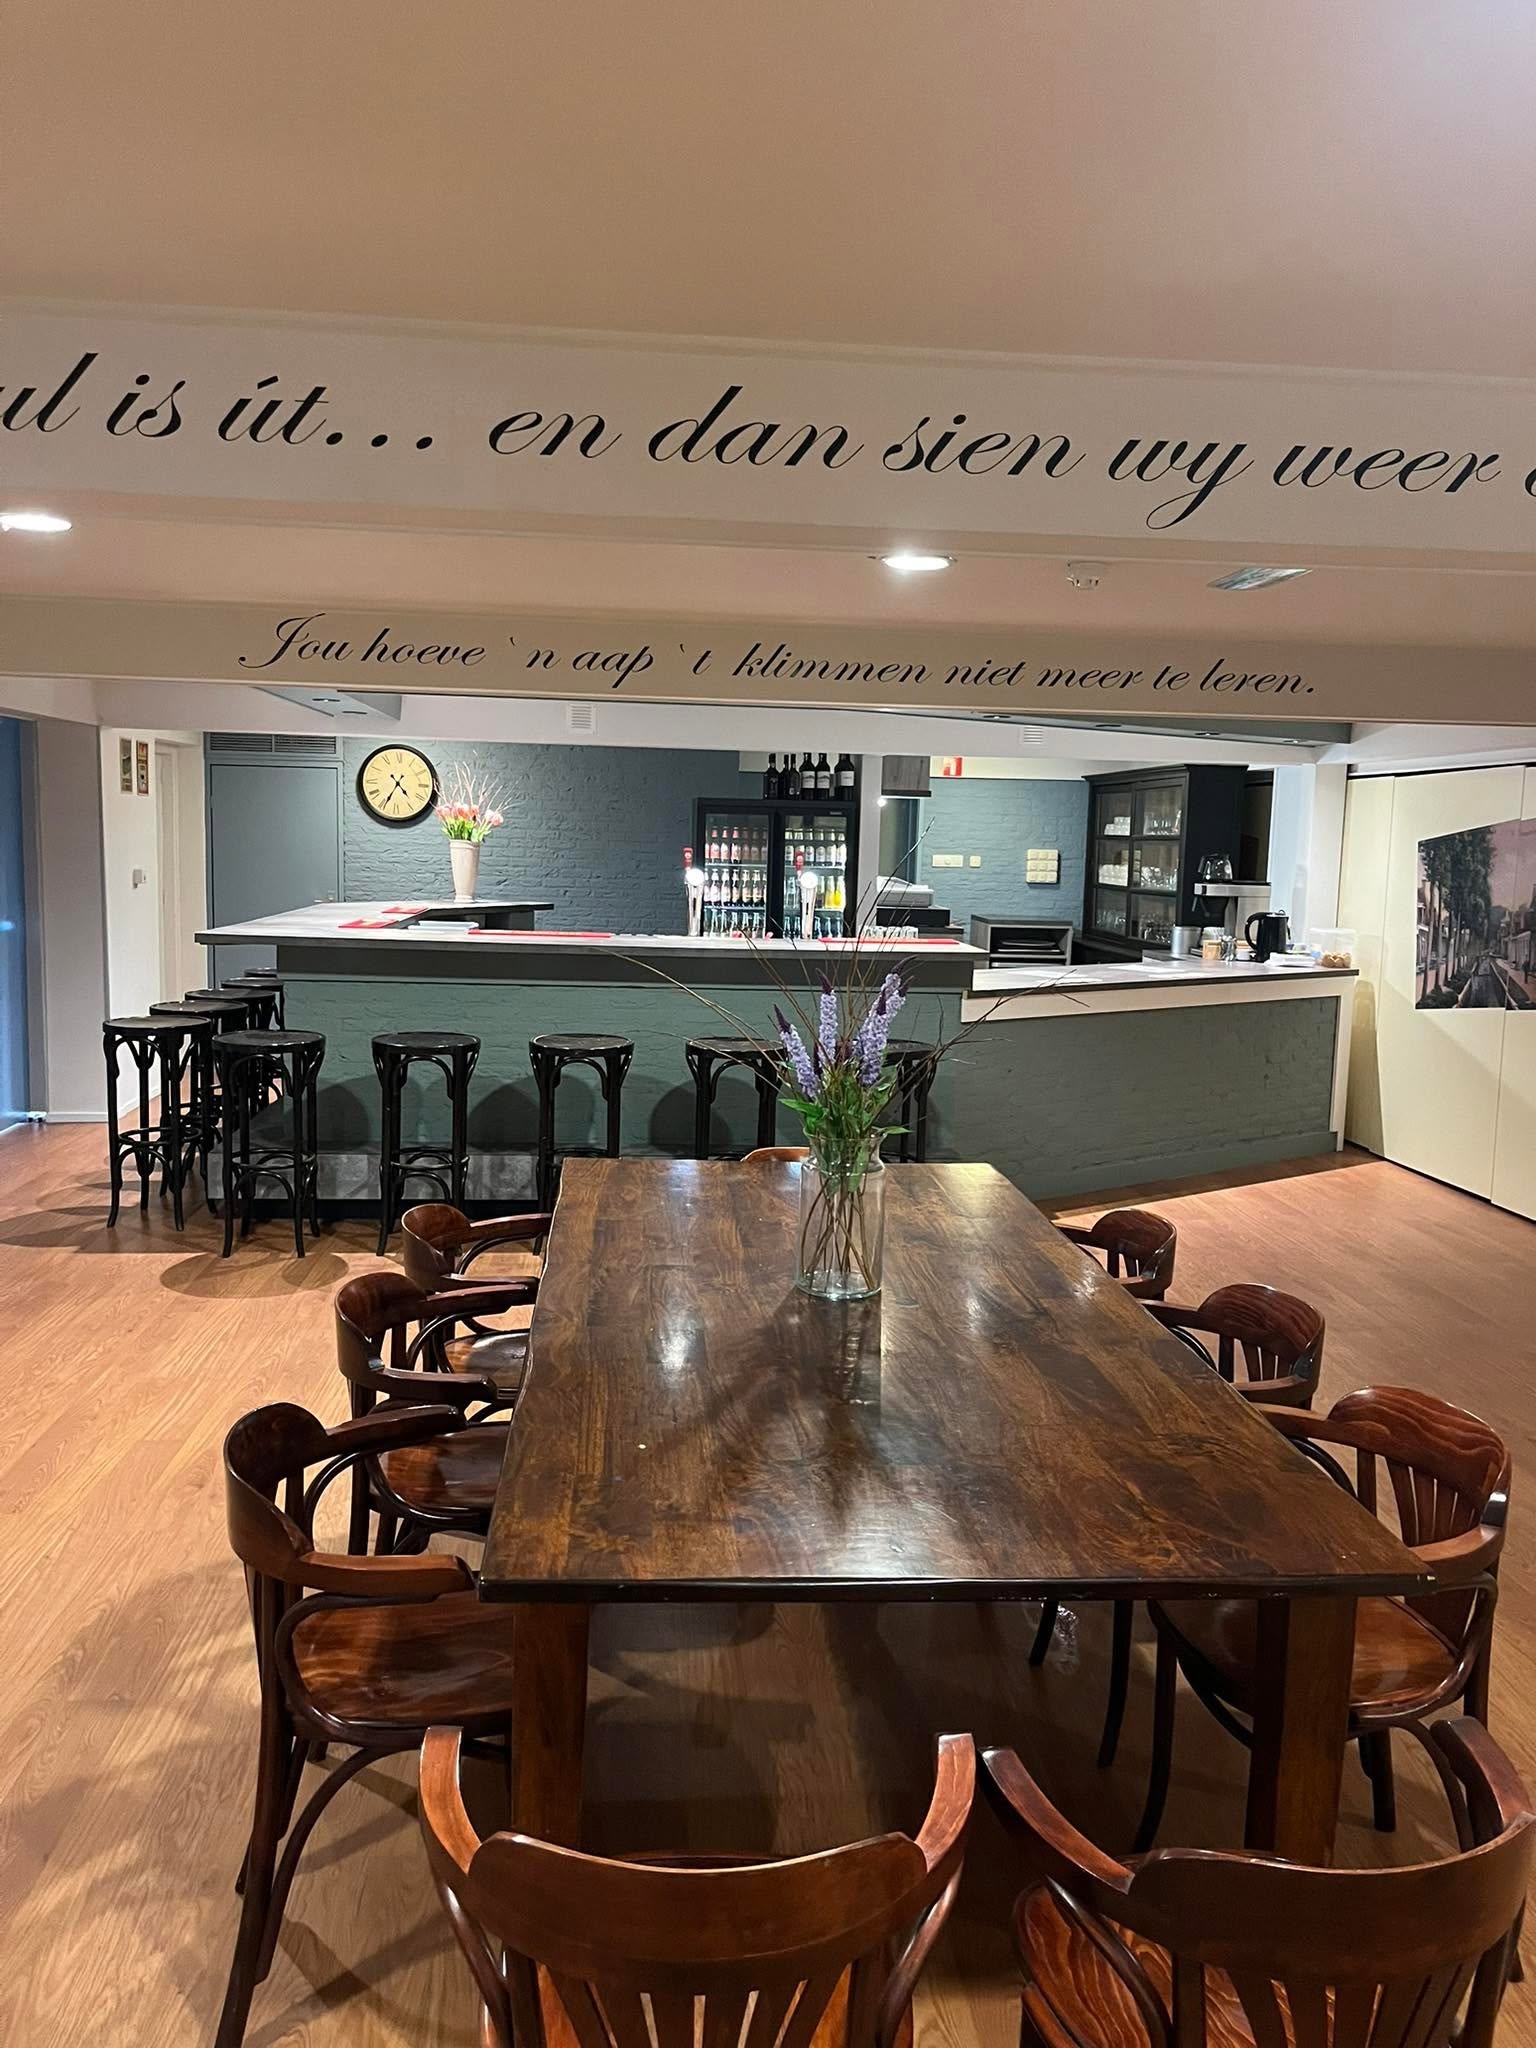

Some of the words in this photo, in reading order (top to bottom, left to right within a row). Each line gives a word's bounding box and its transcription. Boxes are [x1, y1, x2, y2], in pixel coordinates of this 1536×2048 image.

[106, 374, 186, 438] is
[488, 411, 623, 459] en
[647, 385, 865, 470] dan
[882, 413, 1087, 479] sien
[1107, 439, 1255, 530] wy
[1272, 444, 1502, 493] weer
[238, 612, 354, 669] Jou
[360, 627, 488, 667] hoeve
[572, 645, 654, 689] aap
[731, 642, 929, 684] klimmen
[943, 659, 1027, 687] niet
[1036, 668, 1145, 689] meer
[1152, 665, 1191, 691] te
[1199, 658, 1315, 694] leren.
